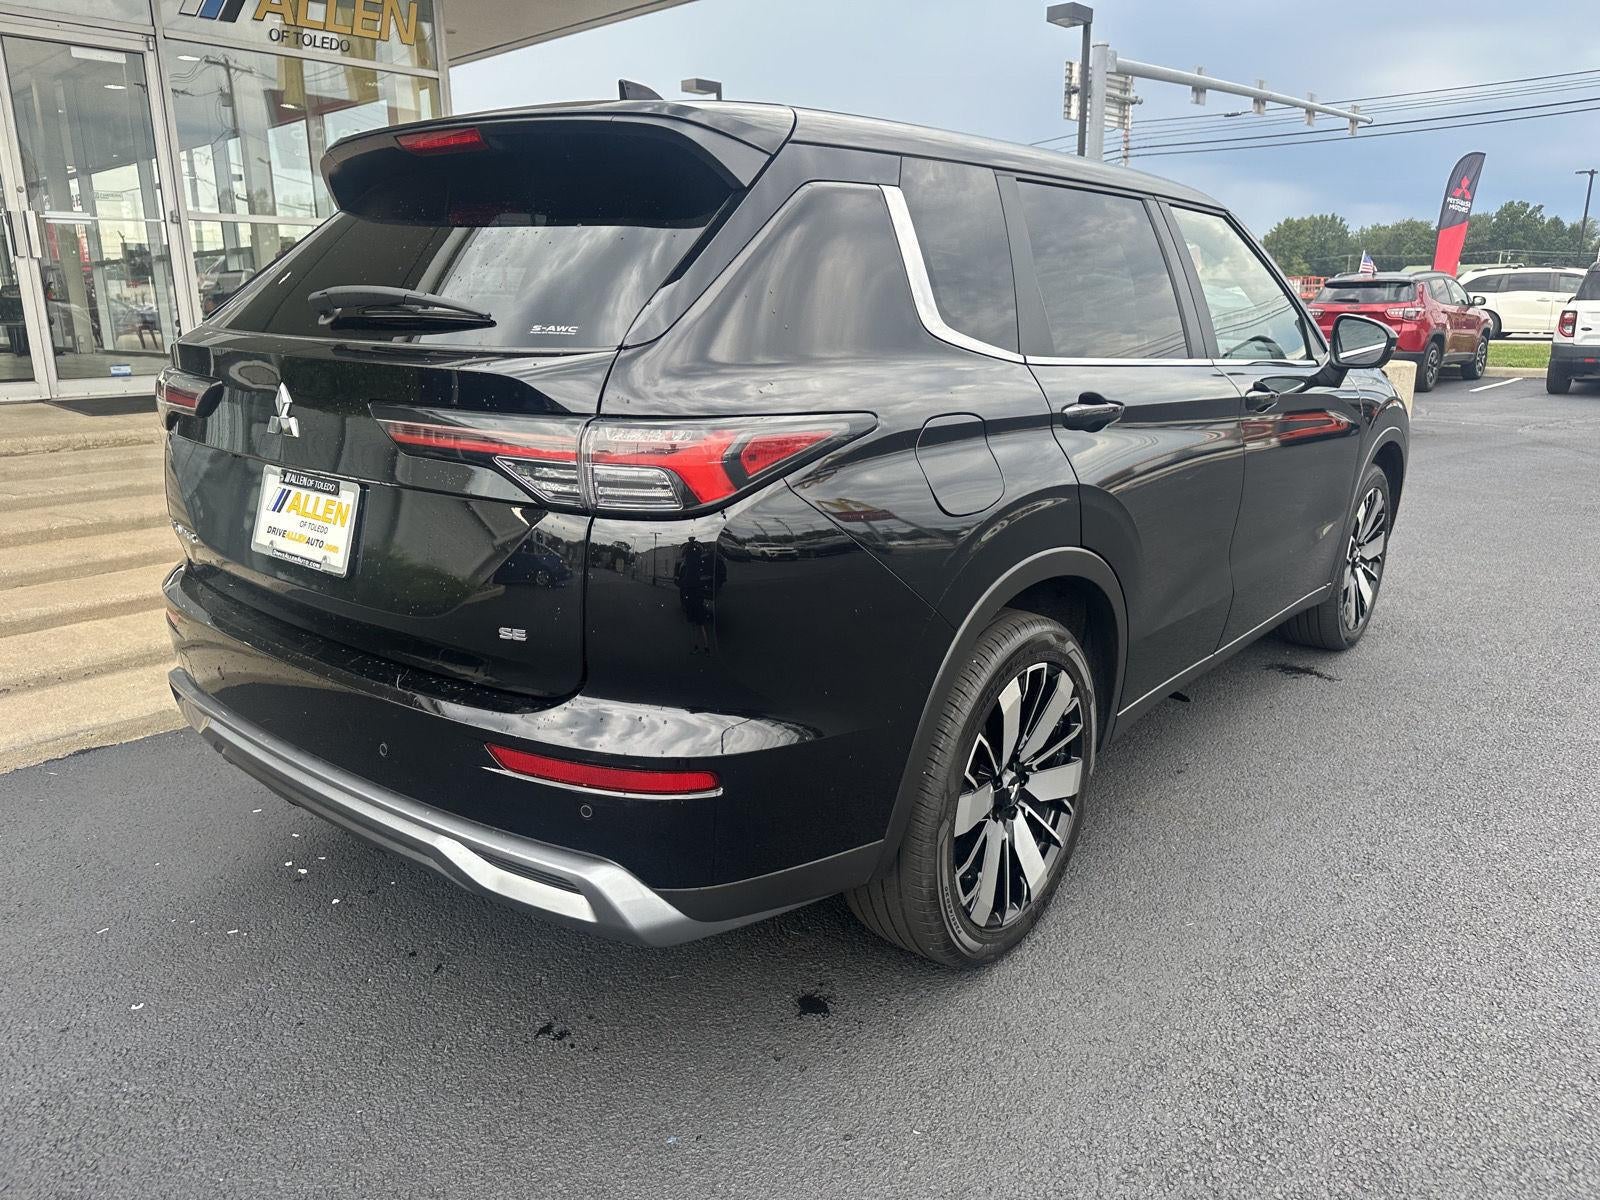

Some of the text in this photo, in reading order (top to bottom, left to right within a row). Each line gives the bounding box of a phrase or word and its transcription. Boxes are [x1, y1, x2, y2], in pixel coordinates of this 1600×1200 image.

[252, 0, 417, 46] ALLEN
[269, 28, 351, 52] OF TOLEDO
[290, 474, 307, 486] ALLEN
[315, 480, 336, 492] TOLEDO
[286, 491, 350, 528] ALLEN
[299, 520, 329, 535] OF TOLEDO
[498, 627, 527, 641] SE
